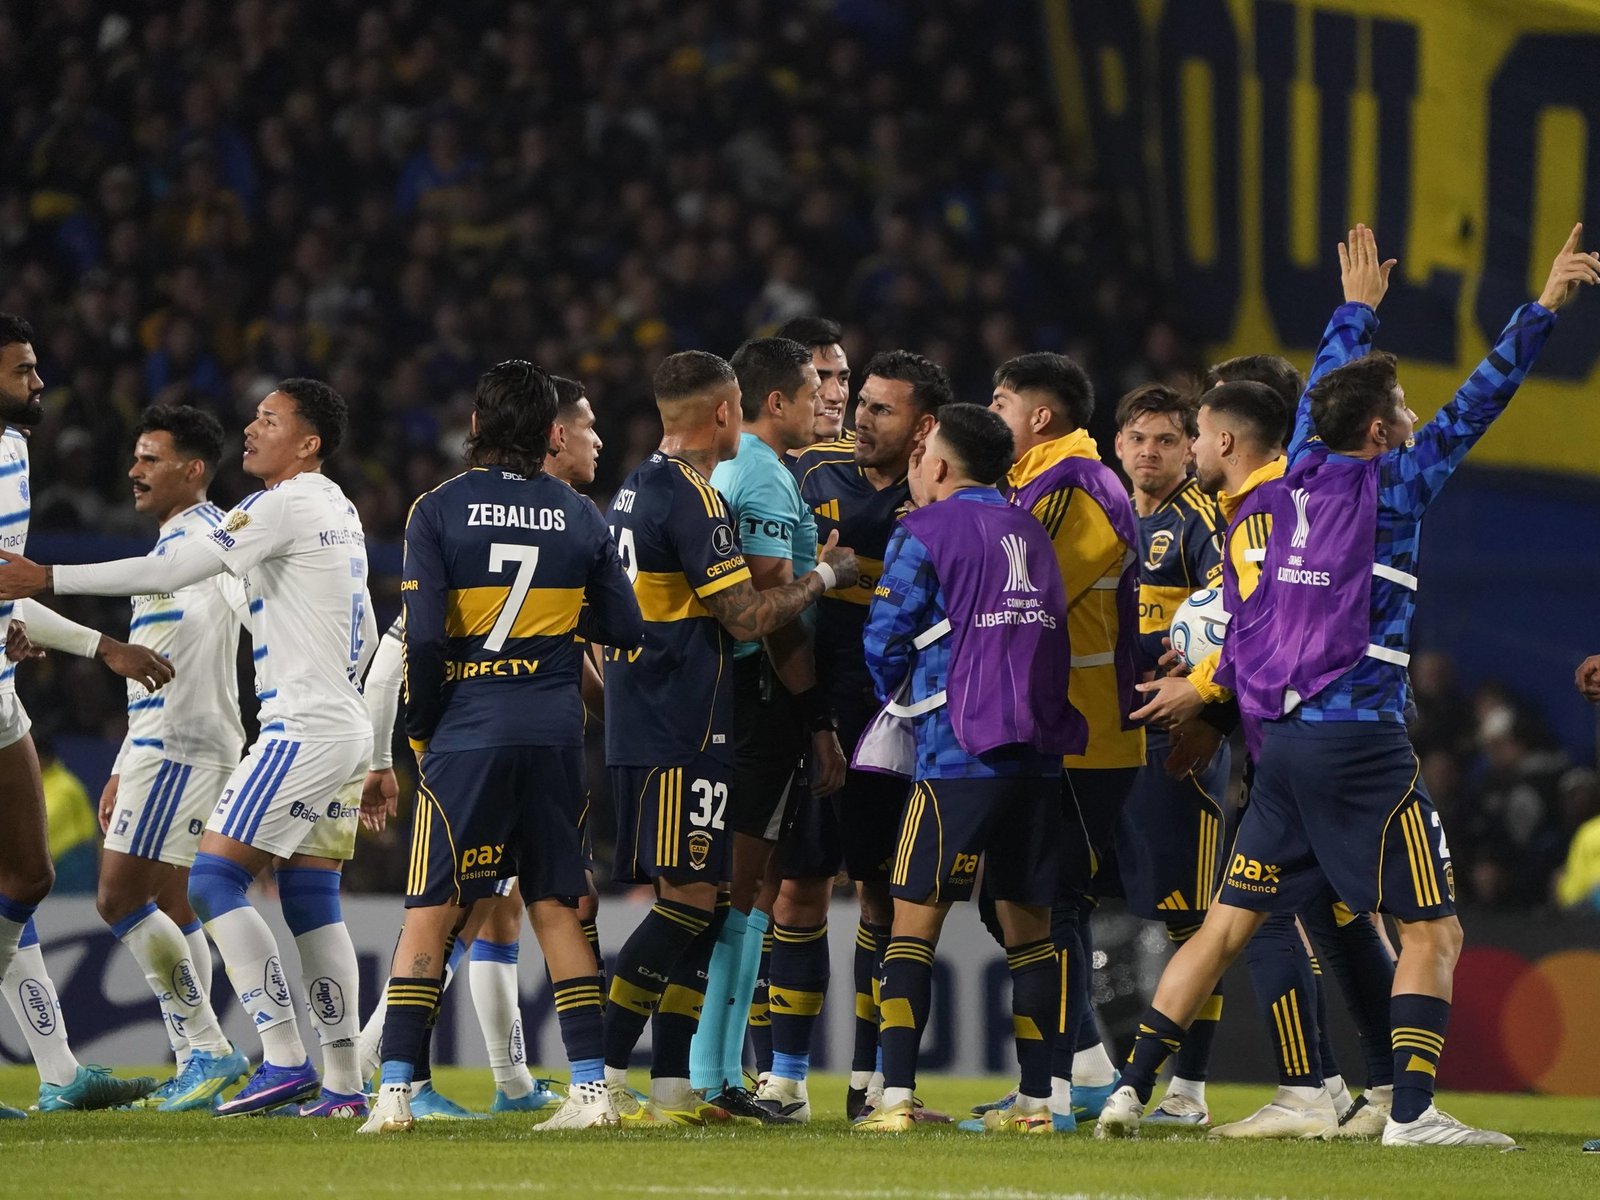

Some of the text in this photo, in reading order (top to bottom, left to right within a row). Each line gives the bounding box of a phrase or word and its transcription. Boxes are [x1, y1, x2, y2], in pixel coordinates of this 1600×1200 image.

[467, 503, 566, 531] ZEBALLOS
[746, 518, 789, 541] TCL
[483, 543, 539, 652] 7
[975, 609, 1057, 630] LIBERTADOES
[689, 778, 729, 830] 32
[1227, 878, 1277, 894] assistance
[179, 964, 200, 1002] Kodilar
[318, 980, 338, 1019] Kodilar
[25, 984, 53, 1028] Kodilar
[514, 1024, 525, 1064] Kodilar
